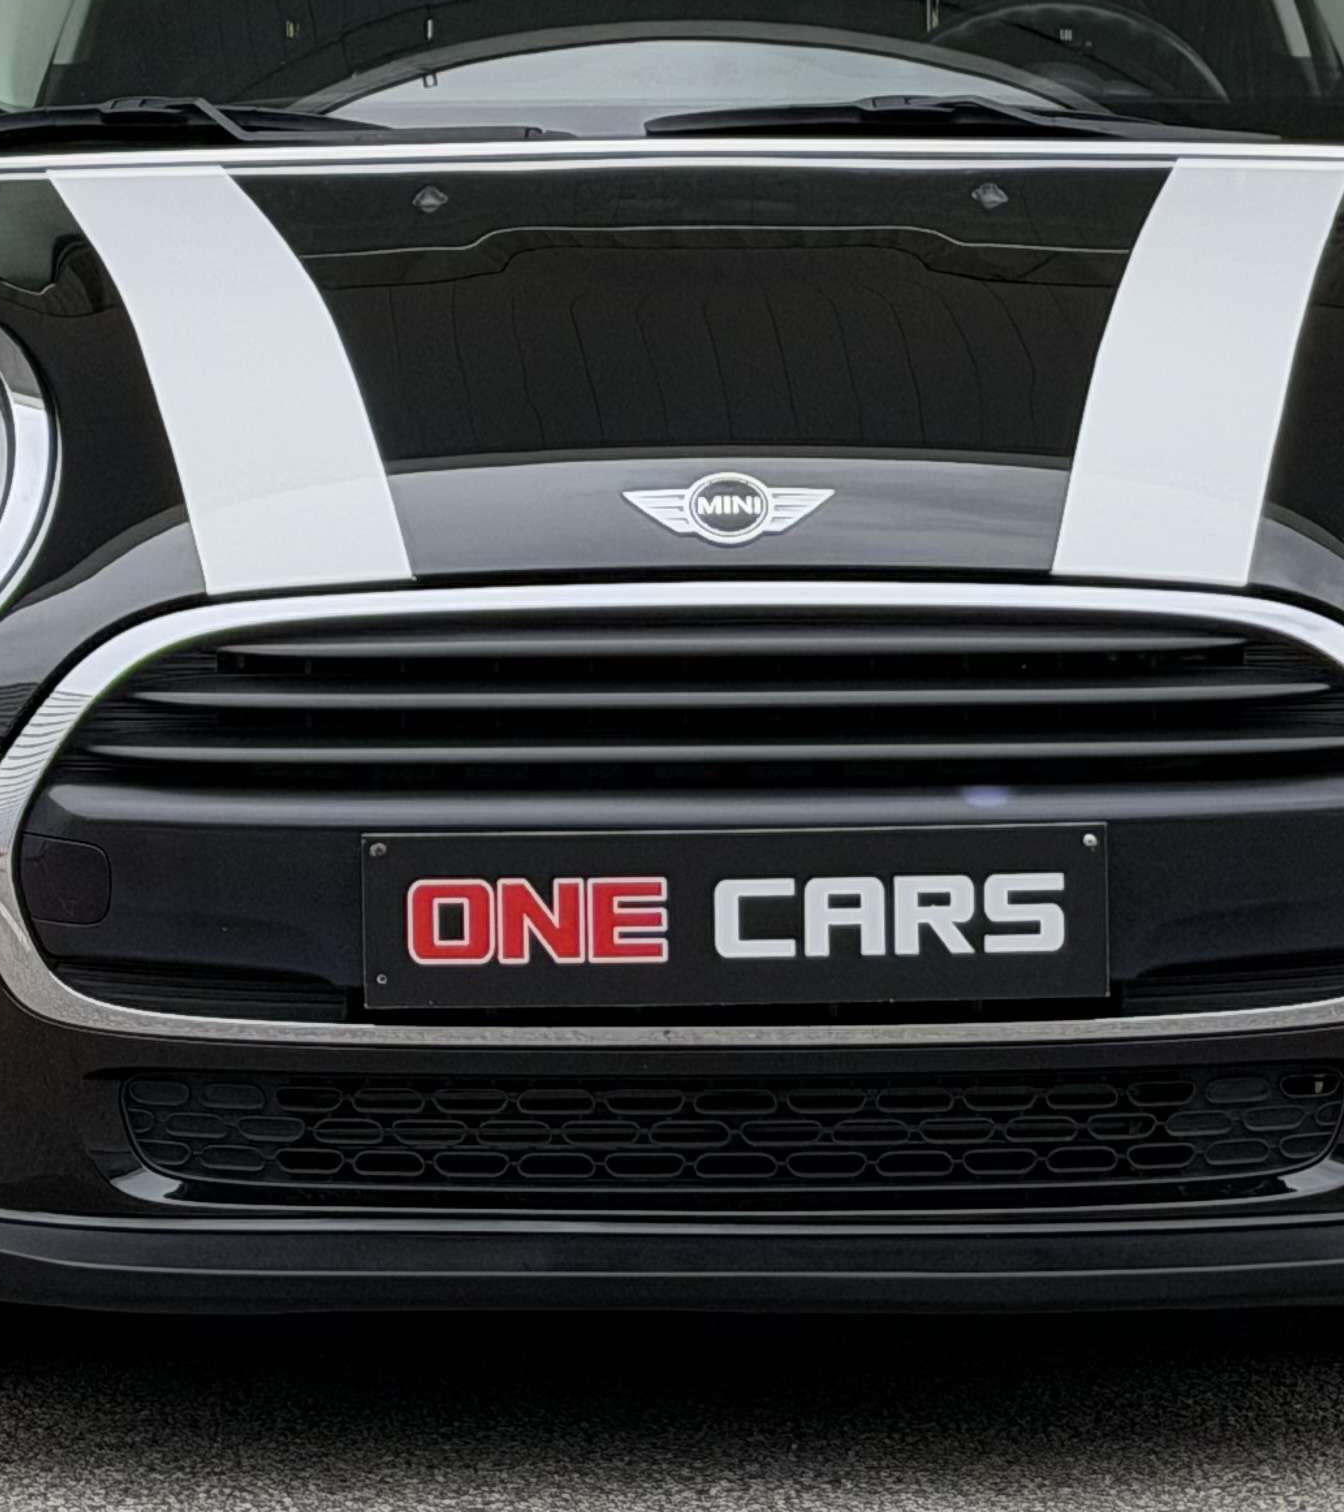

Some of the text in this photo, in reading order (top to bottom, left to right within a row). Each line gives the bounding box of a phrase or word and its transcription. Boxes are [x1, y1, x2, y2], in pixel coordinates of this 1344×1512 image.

[697, 495, 761, 515] MINI
[406, 872, 1066, 965] ONE CARS
